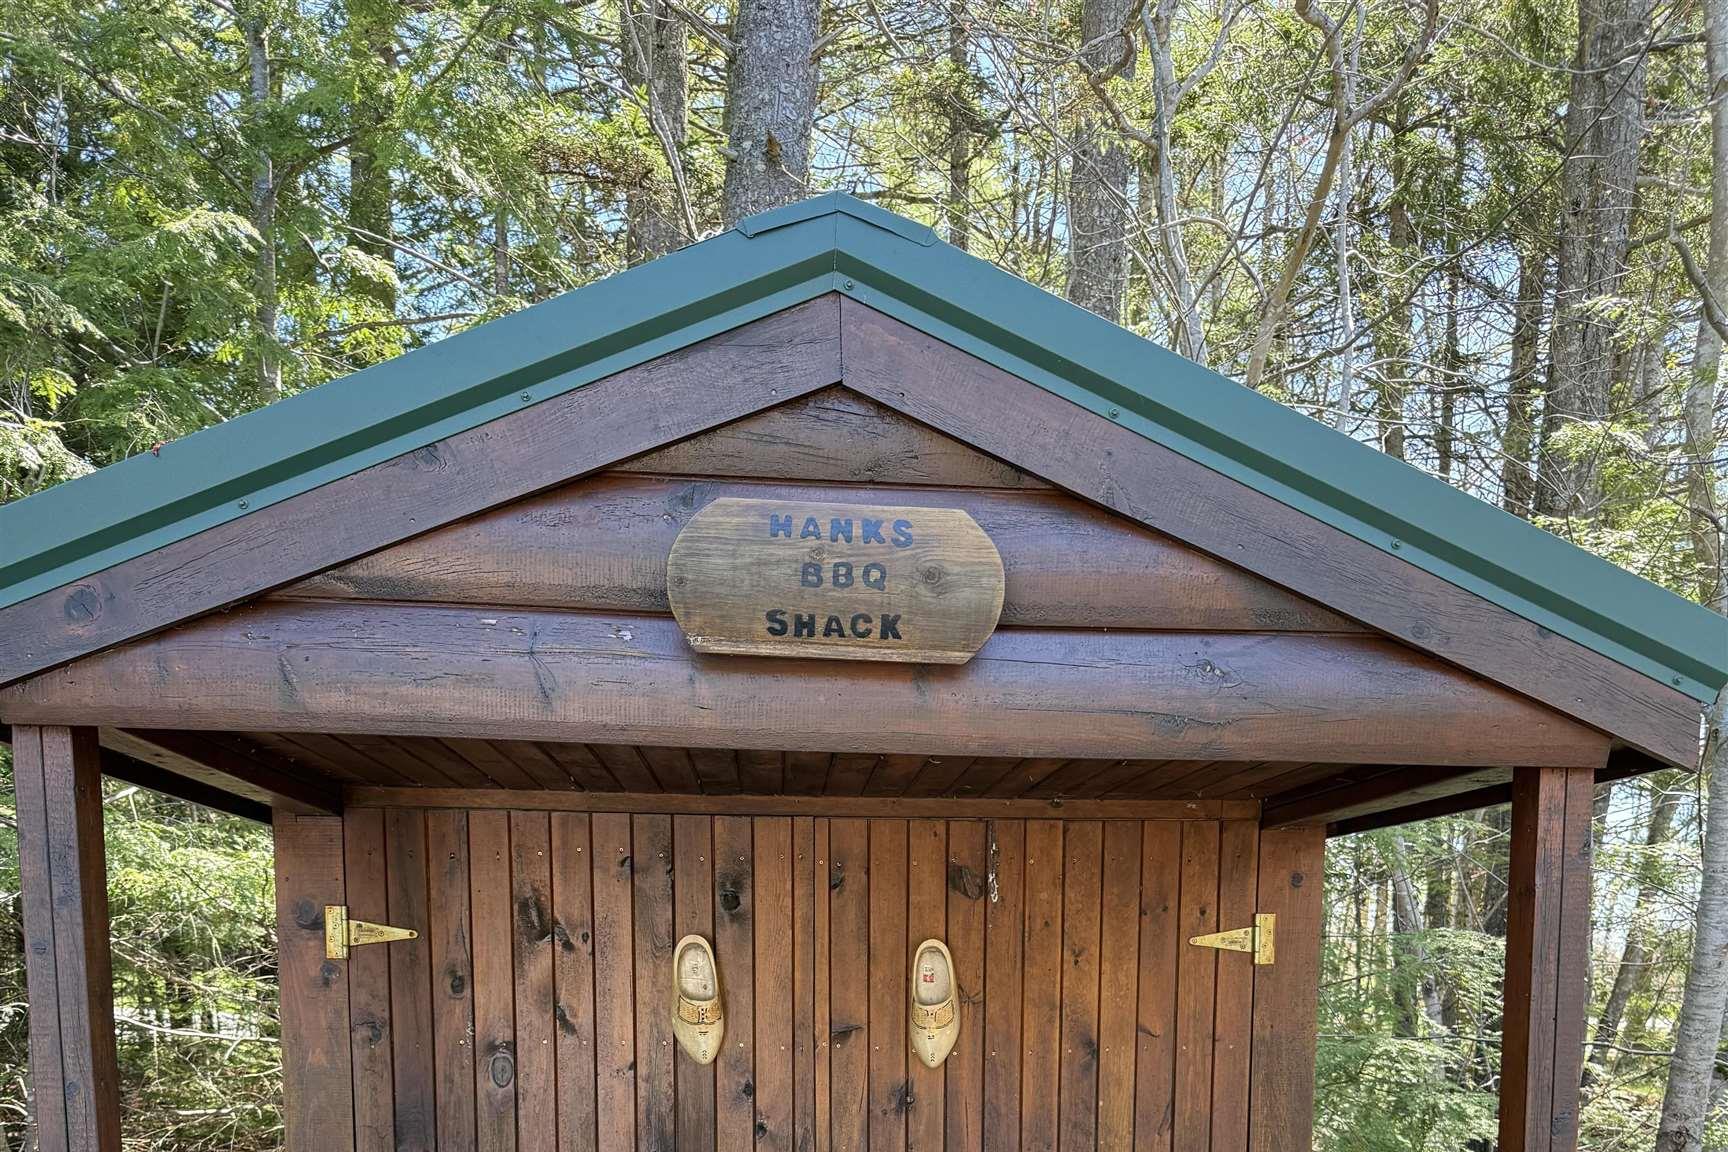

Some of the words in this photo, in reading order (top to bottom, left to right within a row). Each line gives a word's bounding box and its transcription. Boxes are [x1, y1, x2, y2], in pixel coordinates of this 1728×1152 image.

[770, 514, 913, 548] HANKS
[801, 562, 887, 591] BBQ
[766, 609, 903, 640] SHACK
